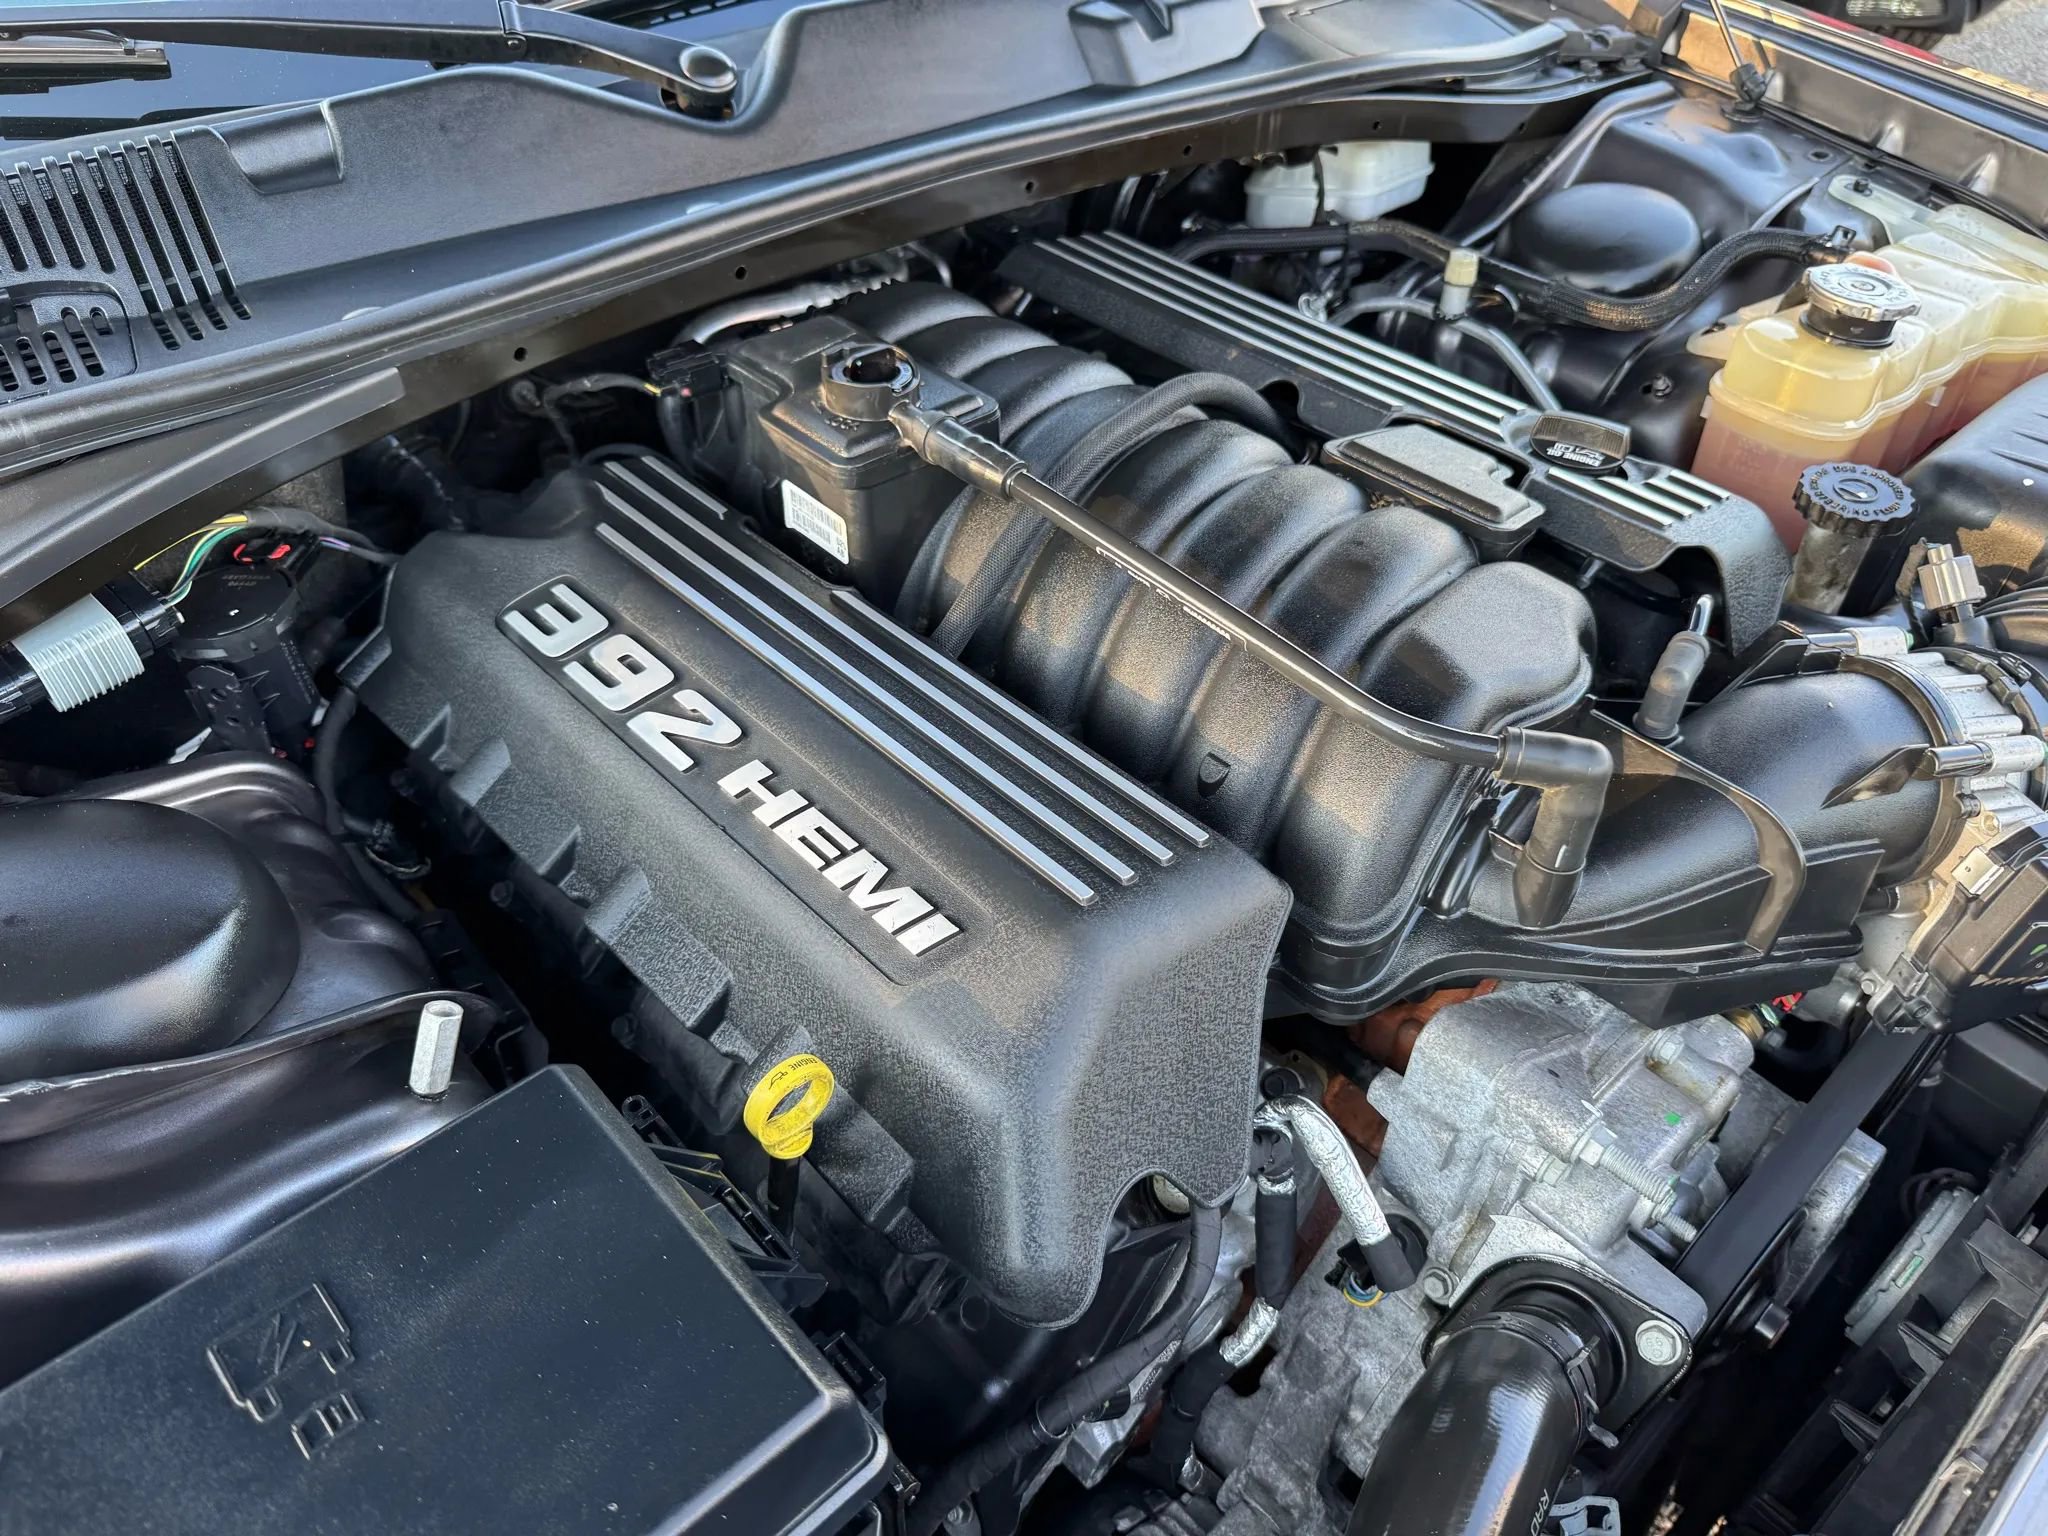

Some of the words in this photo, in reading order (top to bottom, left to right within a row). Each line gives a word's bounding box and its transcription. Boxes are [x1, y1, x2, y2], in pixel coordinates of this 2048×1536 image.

[1546, 447, 1563, 457] OIL
[1562, 452, 1601, 467] ENGINE
[1861, 468, 1905, 500] APPROVED
[502, 582, 742, 773] 392
[716, 758, 961, 956] HEMI
[788, 1057, 818, 1071] ENGINE
